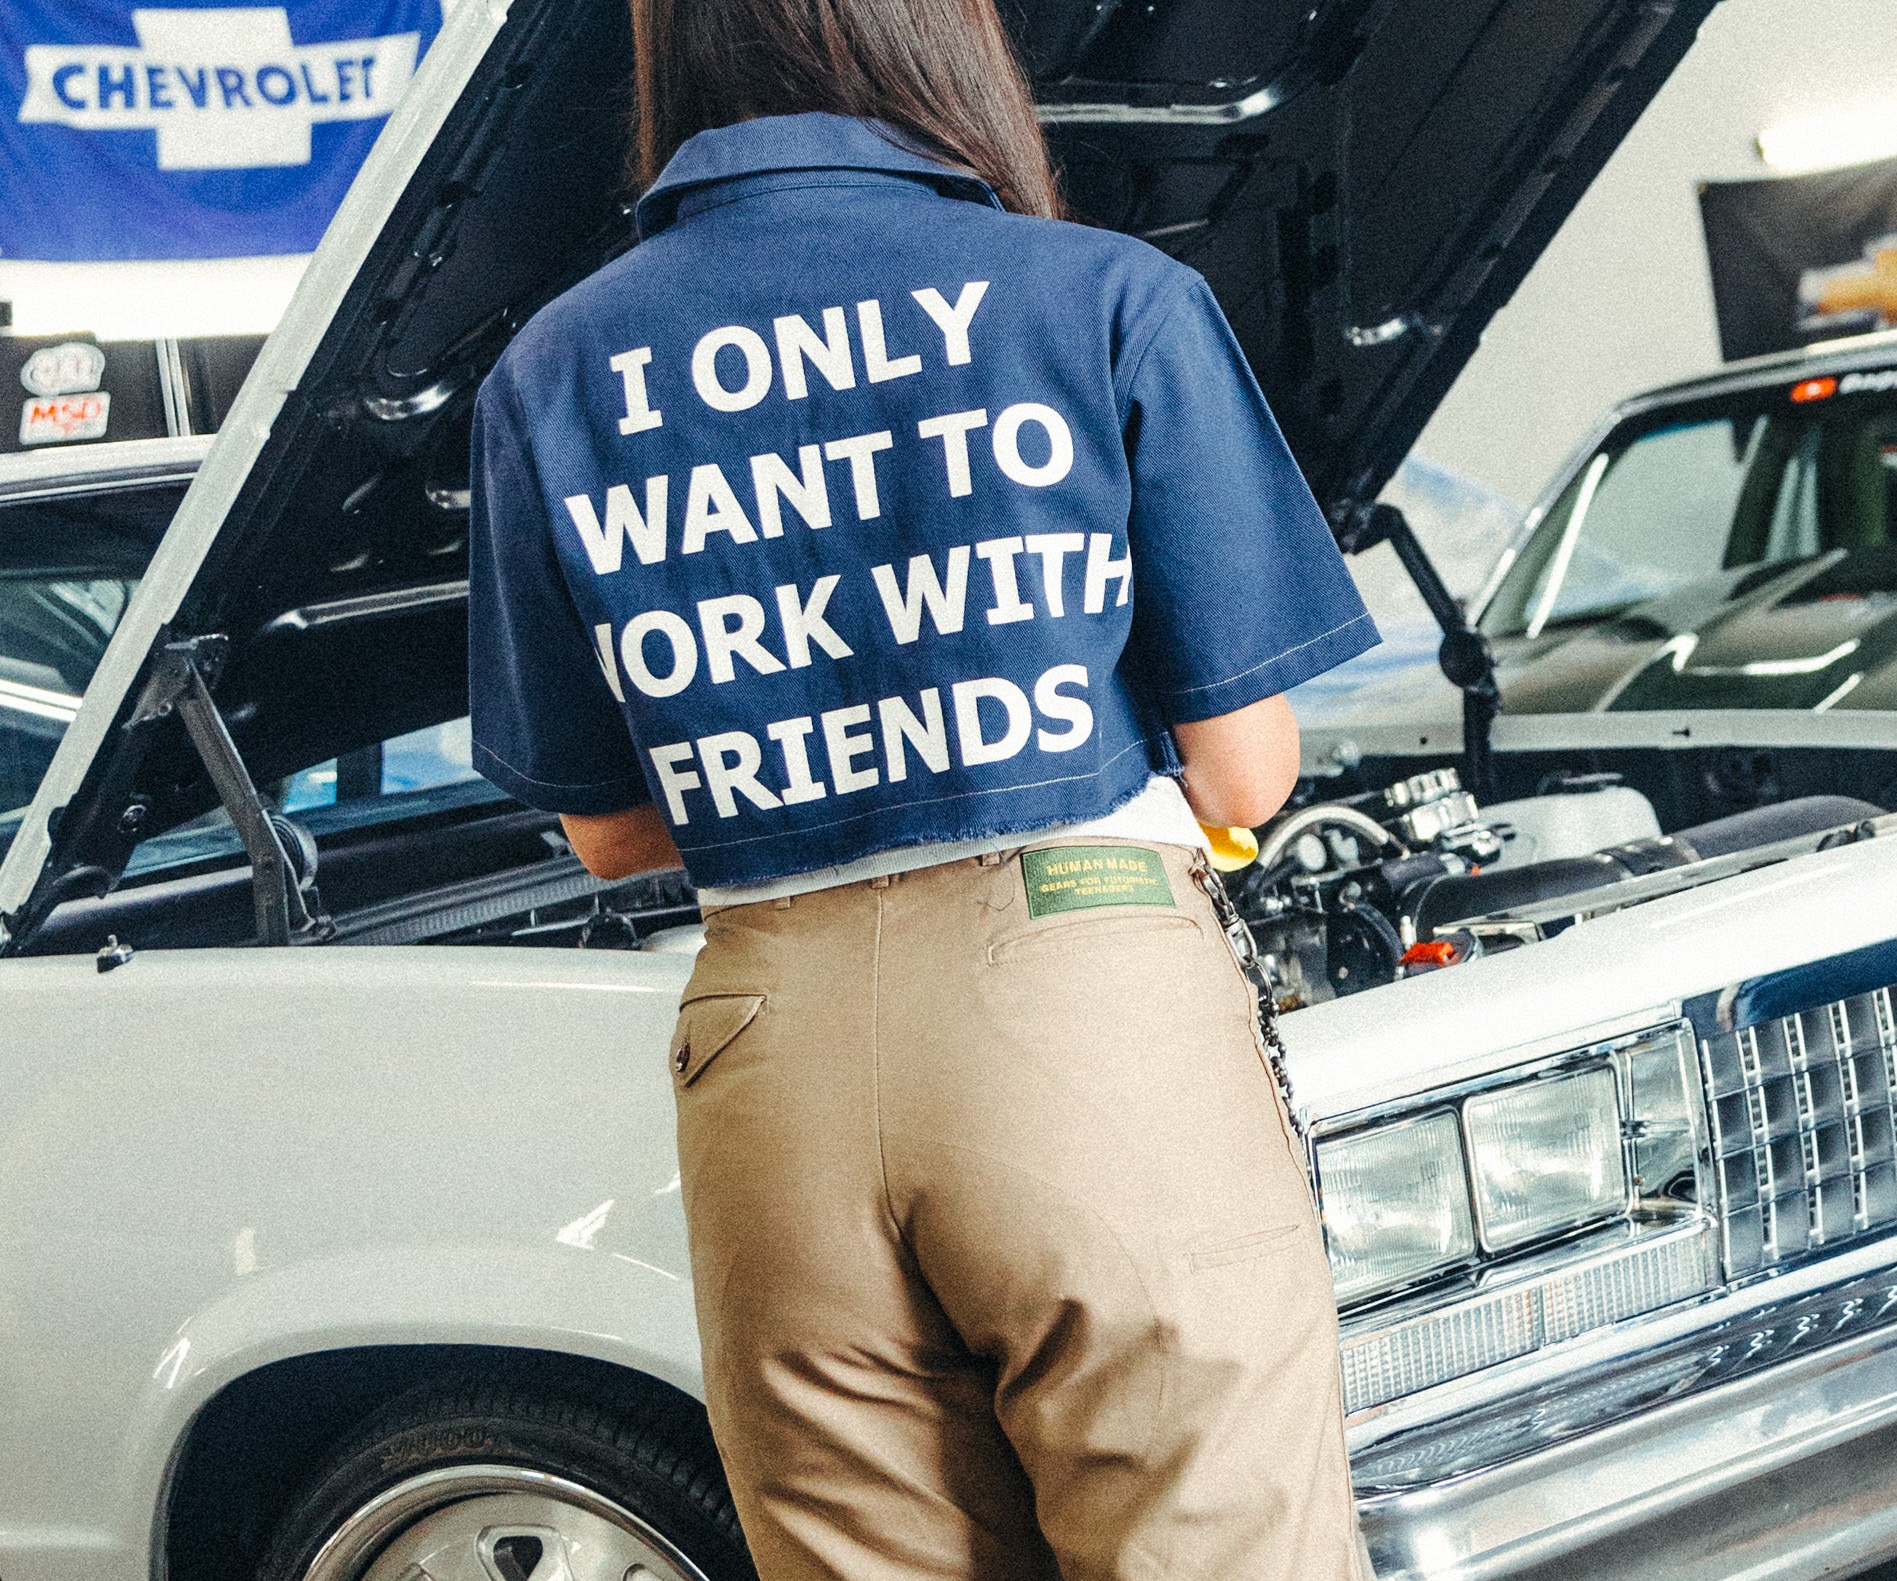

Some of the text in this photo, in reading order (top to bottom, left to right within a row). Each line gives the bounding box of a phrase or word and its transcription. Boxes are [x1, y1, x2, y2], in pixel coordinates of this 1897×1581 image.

[52, 56, 376, 110] CHEVROLET
[609, 280, 991, 436] I ONLY
[564, 402, 1075, 576] WANT TO
[872, 532, 1132, 646] WITH
[648, 663, 1095, 827] FRIENDS
[1040, 880, 1077, 893] GEARS
[1080, 877, 1101, 886] FOR
[1046, 857, 1149, 876] HUMAN MADE
